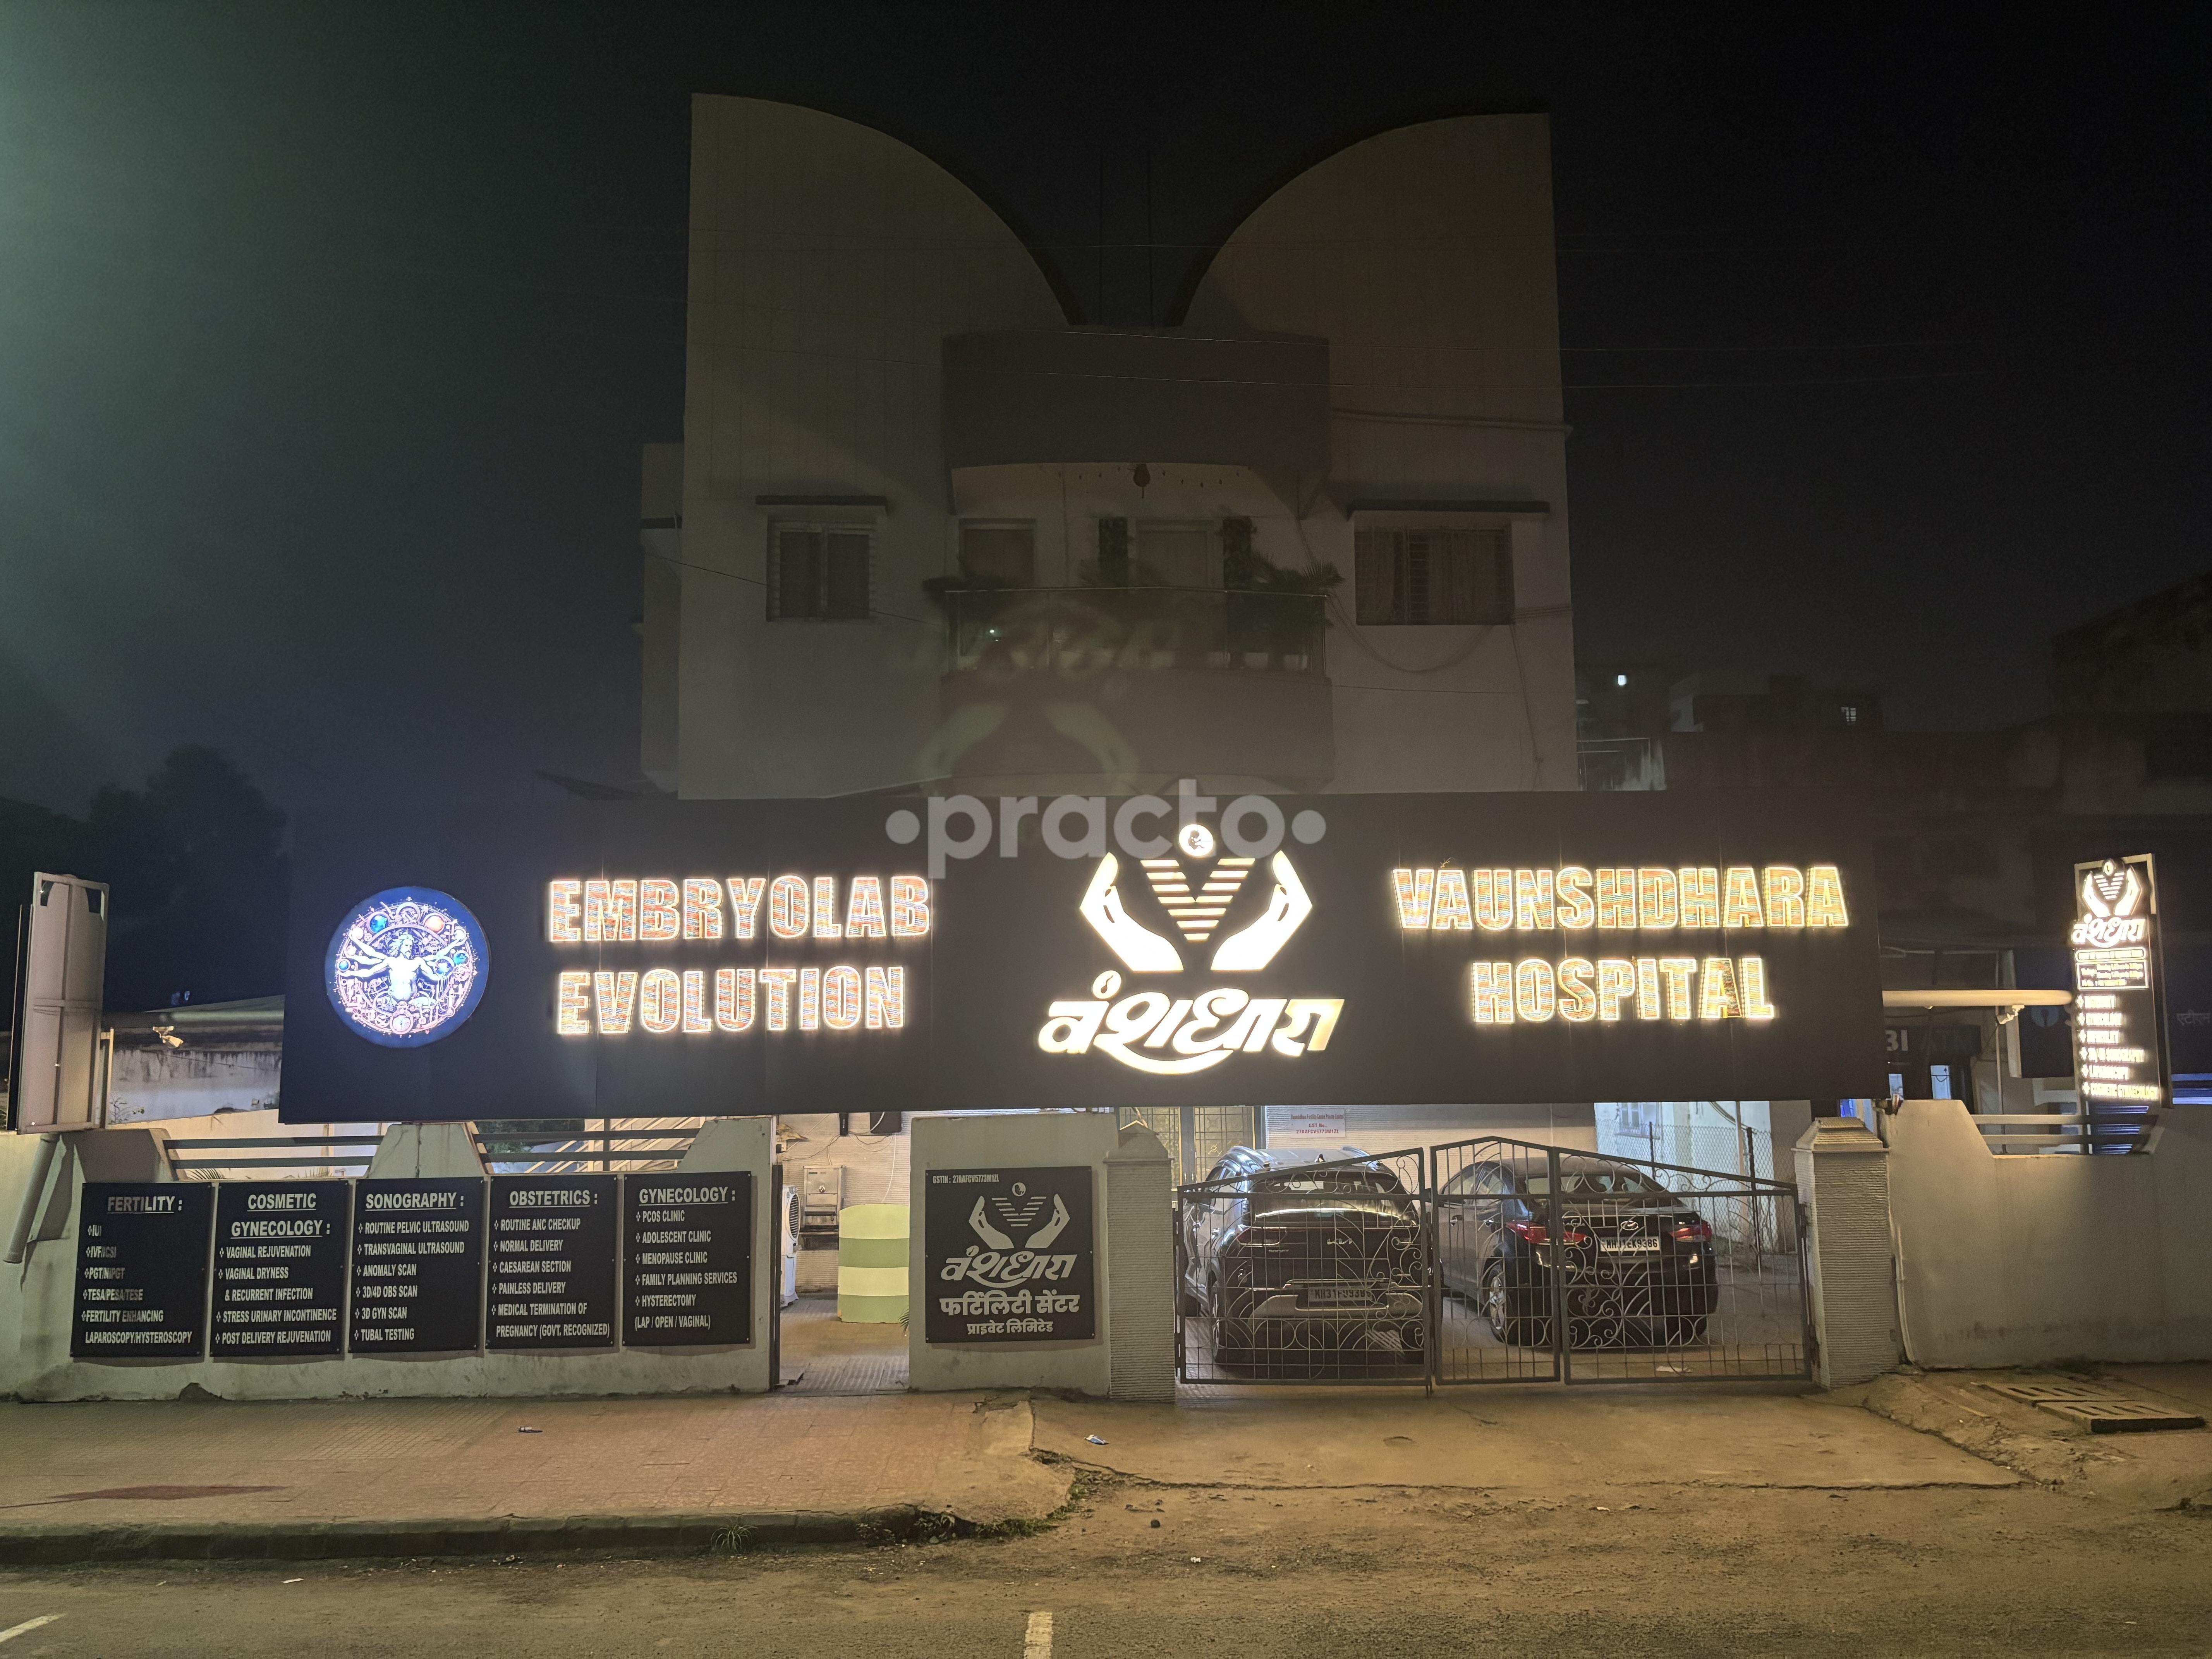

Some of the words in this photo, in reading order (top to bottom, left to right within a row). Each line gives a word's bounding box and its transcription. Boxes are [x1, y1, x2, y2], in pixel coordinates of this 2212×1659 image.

[1393, 866, 1849, 929] VAUNSHDHARA
[549, 875, 931, 942] EMBRYOLAB
[1472, 957, 1775, 1023] HOSPITAL
[556, 966, 905, 1034] EVOLUTION
[248, 1193, 316, 1209] COSMETIC
[366, 1192, 457, 1209] SONOGRAPHY
[510, 1190, 590, 1206] OBSTETRICS
[639, 1187, 728, 1204] GYNECOLOGY
[107, 1196, 175, 1211] FERTILITY
[643, 1211, 660, 1222] PCOS
[663, 1210, 685, 1222] CLINIC
[92, 1225, 101, 1236] IUI
[232, 1220, 323, 1237] GYNECOLOGY
[365, 1222, 395, 1234] ROUTINE
[397, 1221, 421, 1233] PELVIC
[423, 1220, 469, 1233] ULTRASOUND
[501, 1219, 530, 1231] ROUTINE
[532, 1219, 546, 1230] ANC
[548, 1218, 580, 1230] CHECKUP
[642, 1231, 687, 1243] ADOLESCENT
[689, 1230, 711, 1242] CLINIC
[90, 1246, 116, 1257] IVF/ICSI
[227, 1247, 256, 1258] VAGINAL
[258, 1245, 311, 1257] REJUVENATION
[364, 1243, 416, 1255] TRANSVAGINAL
[419, 1242, 464, 1254] ULTRASOUND
[500, 1240, 528, 1252] NORMAL
[530, 1240, 563, 1251] DELIVERY
[642, 1252, 683, 1264] MENOPAUSE
[685, 1252, 707, 1264] CLINIC
[225, 1268, 254, 1279] VAGINAL
[257, 1267, 289, 1279] DRYNESS
[363, 1264, 396, 1276] ANOMALY
[398, 1264, 416, 1276] SCAN
[500, 1261, 539, 1273] CAESAREAN
[542, 1261, 571, 1272] SECTION
[642, 1274, 665, 1285] FAMILY
[668, 1273, 702, 1285] PLANNING
[704, 1272, 737, 1284] SERVICES
[88, 1289, 143, 1300] TESA/PESA/TESE
[225, 1290, 230, 1301] &
[232, 1289, 273, 1301] RECURRENT
[276, 1288, 313, 1300] INFECTION
[363, 1286, 381, 1298] 3D/4D
[383, 1286, 397, 1297] OBS
[399, 1285, 417, 1297] SCAN
[499, 1283, 531, 1294] PAINLESS
[533, 1282, 565, 1293] DELIVERY
[642, 1294, 696, 1307] HYSTERECTOMY
[86, 1310, 121, 1322] FERTILITY
[122, 1310, 163, 1322] ENHANCING
[223, 1310, 249, 1322] STRESS
[251, 1310, 282, 1322] URINARY
[284, 1309, 337, 1321] INCONTINENCE
[362, 1308, 370, 1319] 3D
[372, 1307, 386, 1319] GYN
[388, 1307, 407, 1319] SCAN
[498, 1304, 528, 1316] MEDICAL
[530, 1303, 576, 1315] TERMINATION
[578, 1303, 587, 1314] OF
[635, 1317, 649, 1331] (LAP
[655, 1316, 673, 1328] OPEN
[679, 1315, 710, 1329] VAGINAL)
[86, 1331, 192, 1343] LAPAROSCOPY/HYSTEROSCOPY
[222, 1332, 240, 1344] POST
[242, 1332, 275, 1344] DELIVERY
[277, 1330, 331, 1343] REJUVENATION
[361, 1329, 383, 1341] TUBAL
[385, 1328, 414, 1340] TESTING
[496, 1325, 538, 1337] PREGNANCY
[540, 1324, 561, 1339] (GOVT.
[563, 1323, 610, 1338] RECOGNIZED)
